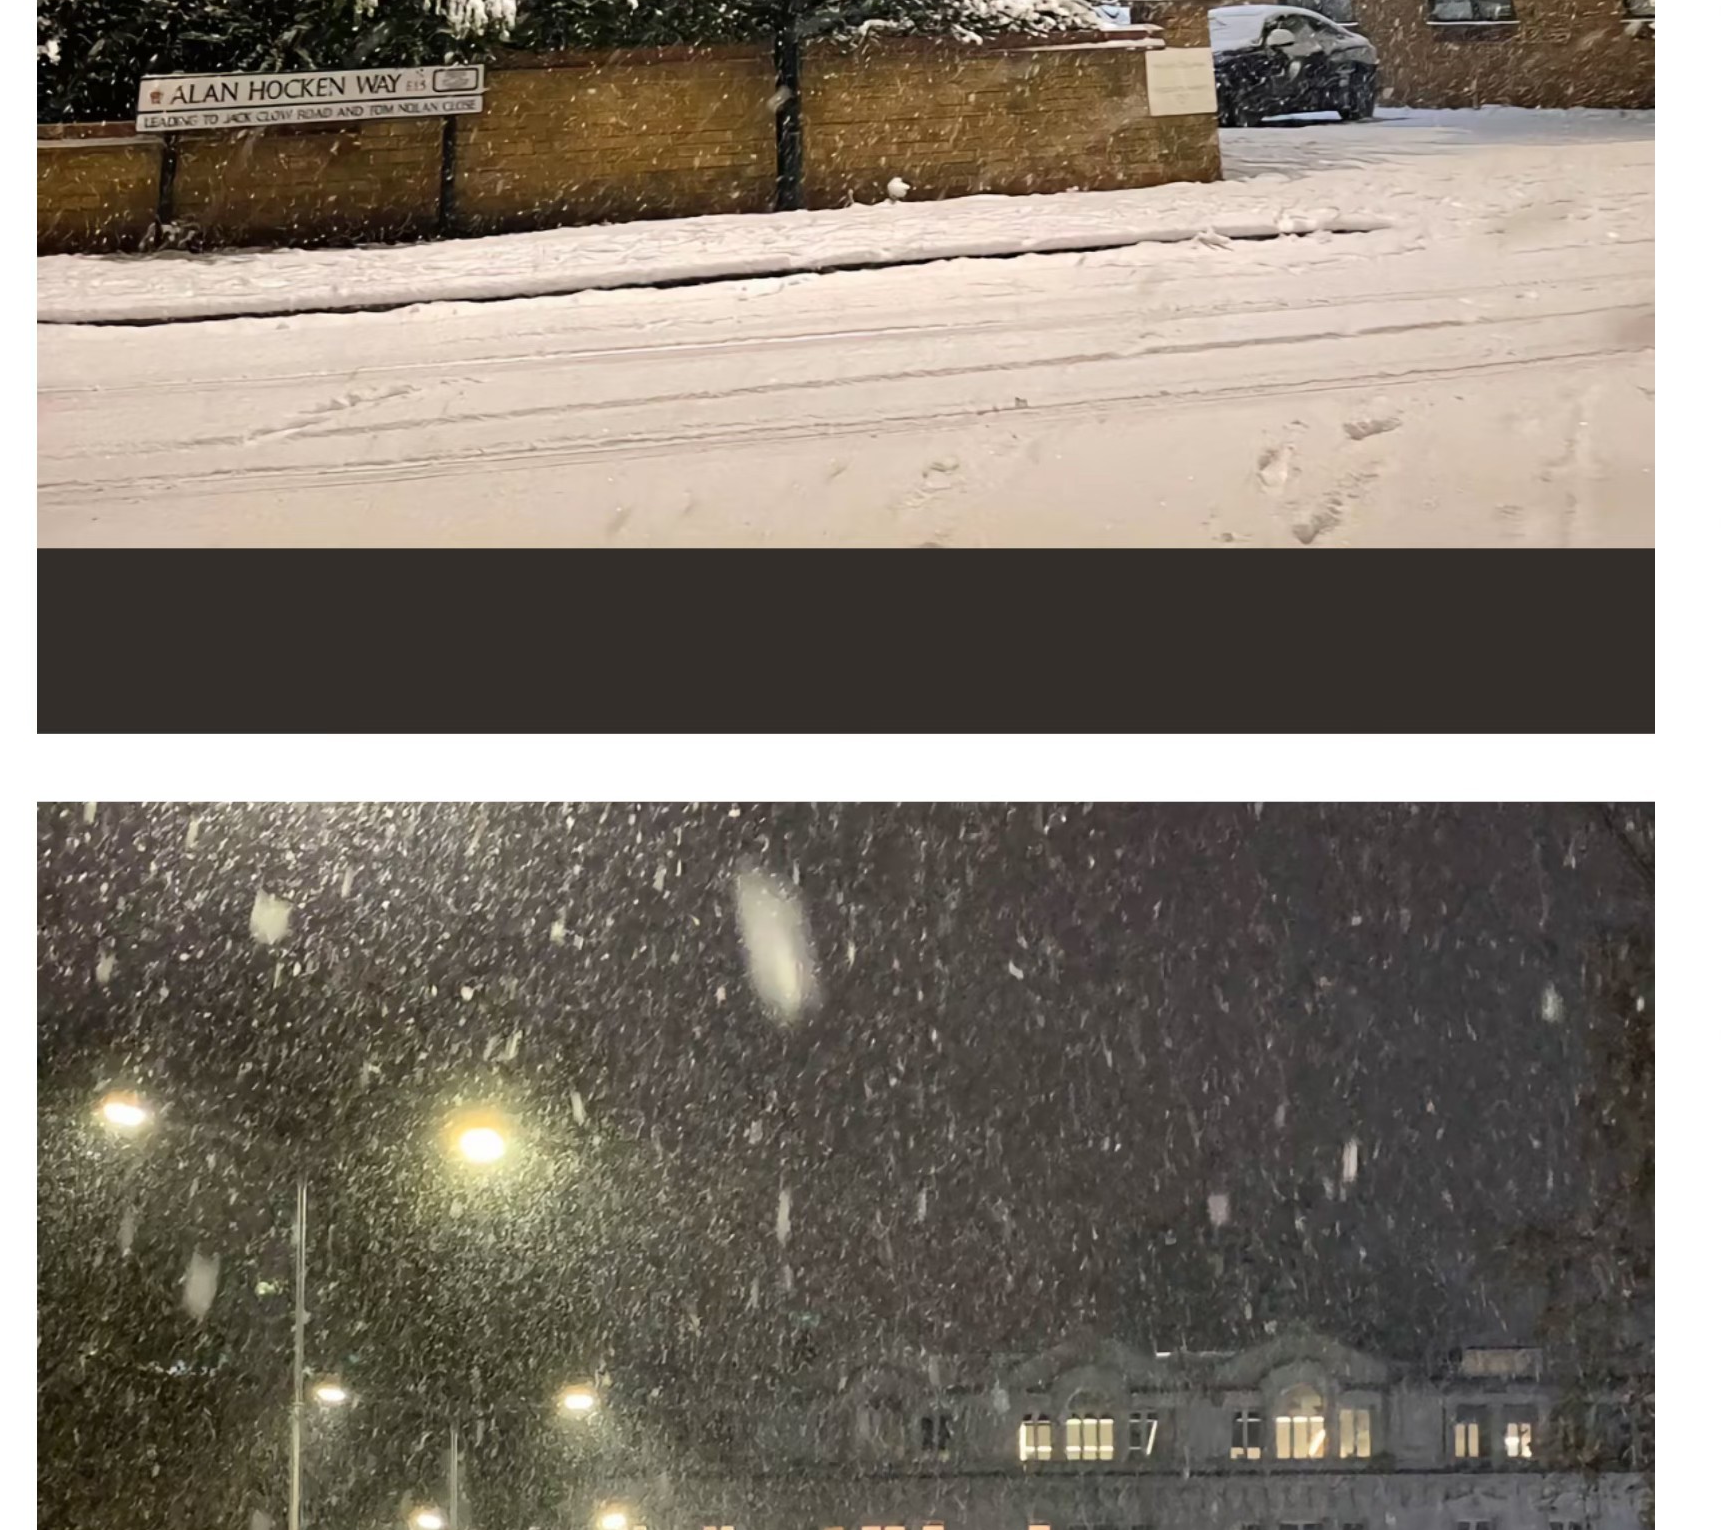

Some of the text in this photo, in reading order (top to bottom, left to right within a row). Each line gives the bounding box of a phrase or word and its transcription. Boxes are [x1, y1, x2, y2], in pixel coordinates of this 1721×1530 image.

[170, 82, 239, 105] ALAN
[248, 76, 345, 101] HOCKEN
[356, 73, 402, 94] WAY
[144, 99, 476, 128] LEADING TO JACK CLOW ROAD AND TOM NOLAN CLOSE
